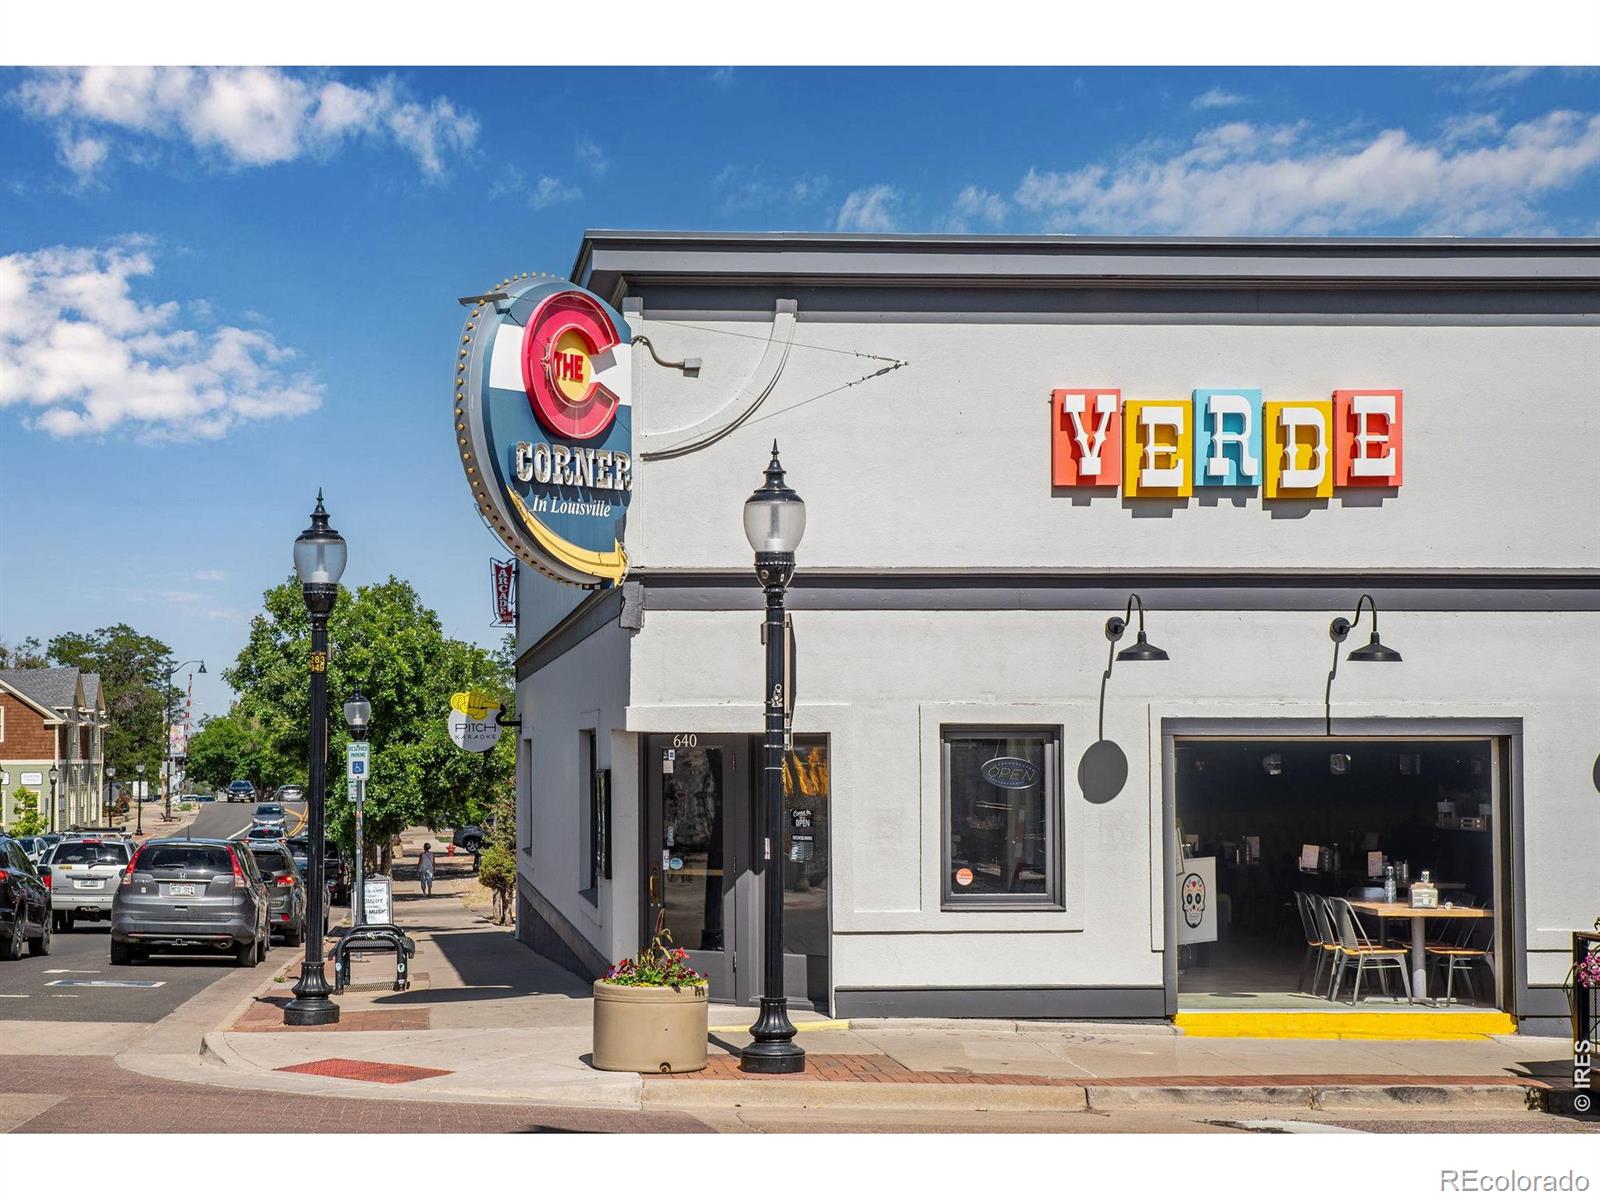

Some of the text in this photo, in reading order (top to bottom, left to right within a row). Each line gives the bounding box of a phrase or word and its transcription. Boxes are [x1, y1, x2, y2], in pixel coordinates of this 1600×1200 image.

[554, 351, 584, 381] THE
[1063, 394, 1397, 488] VERDE
[515, 440, 634, 491] CORNER
[533, 494, 611, 517] In Louisville
[498, 569, 509, 615] ARCADE
[455, 723, 497, 733] PITCH
[673, 733, 698, 748] 640
[988, 766, 1036, 782] OPEN
[795, 819, 811, 828] OPEN
